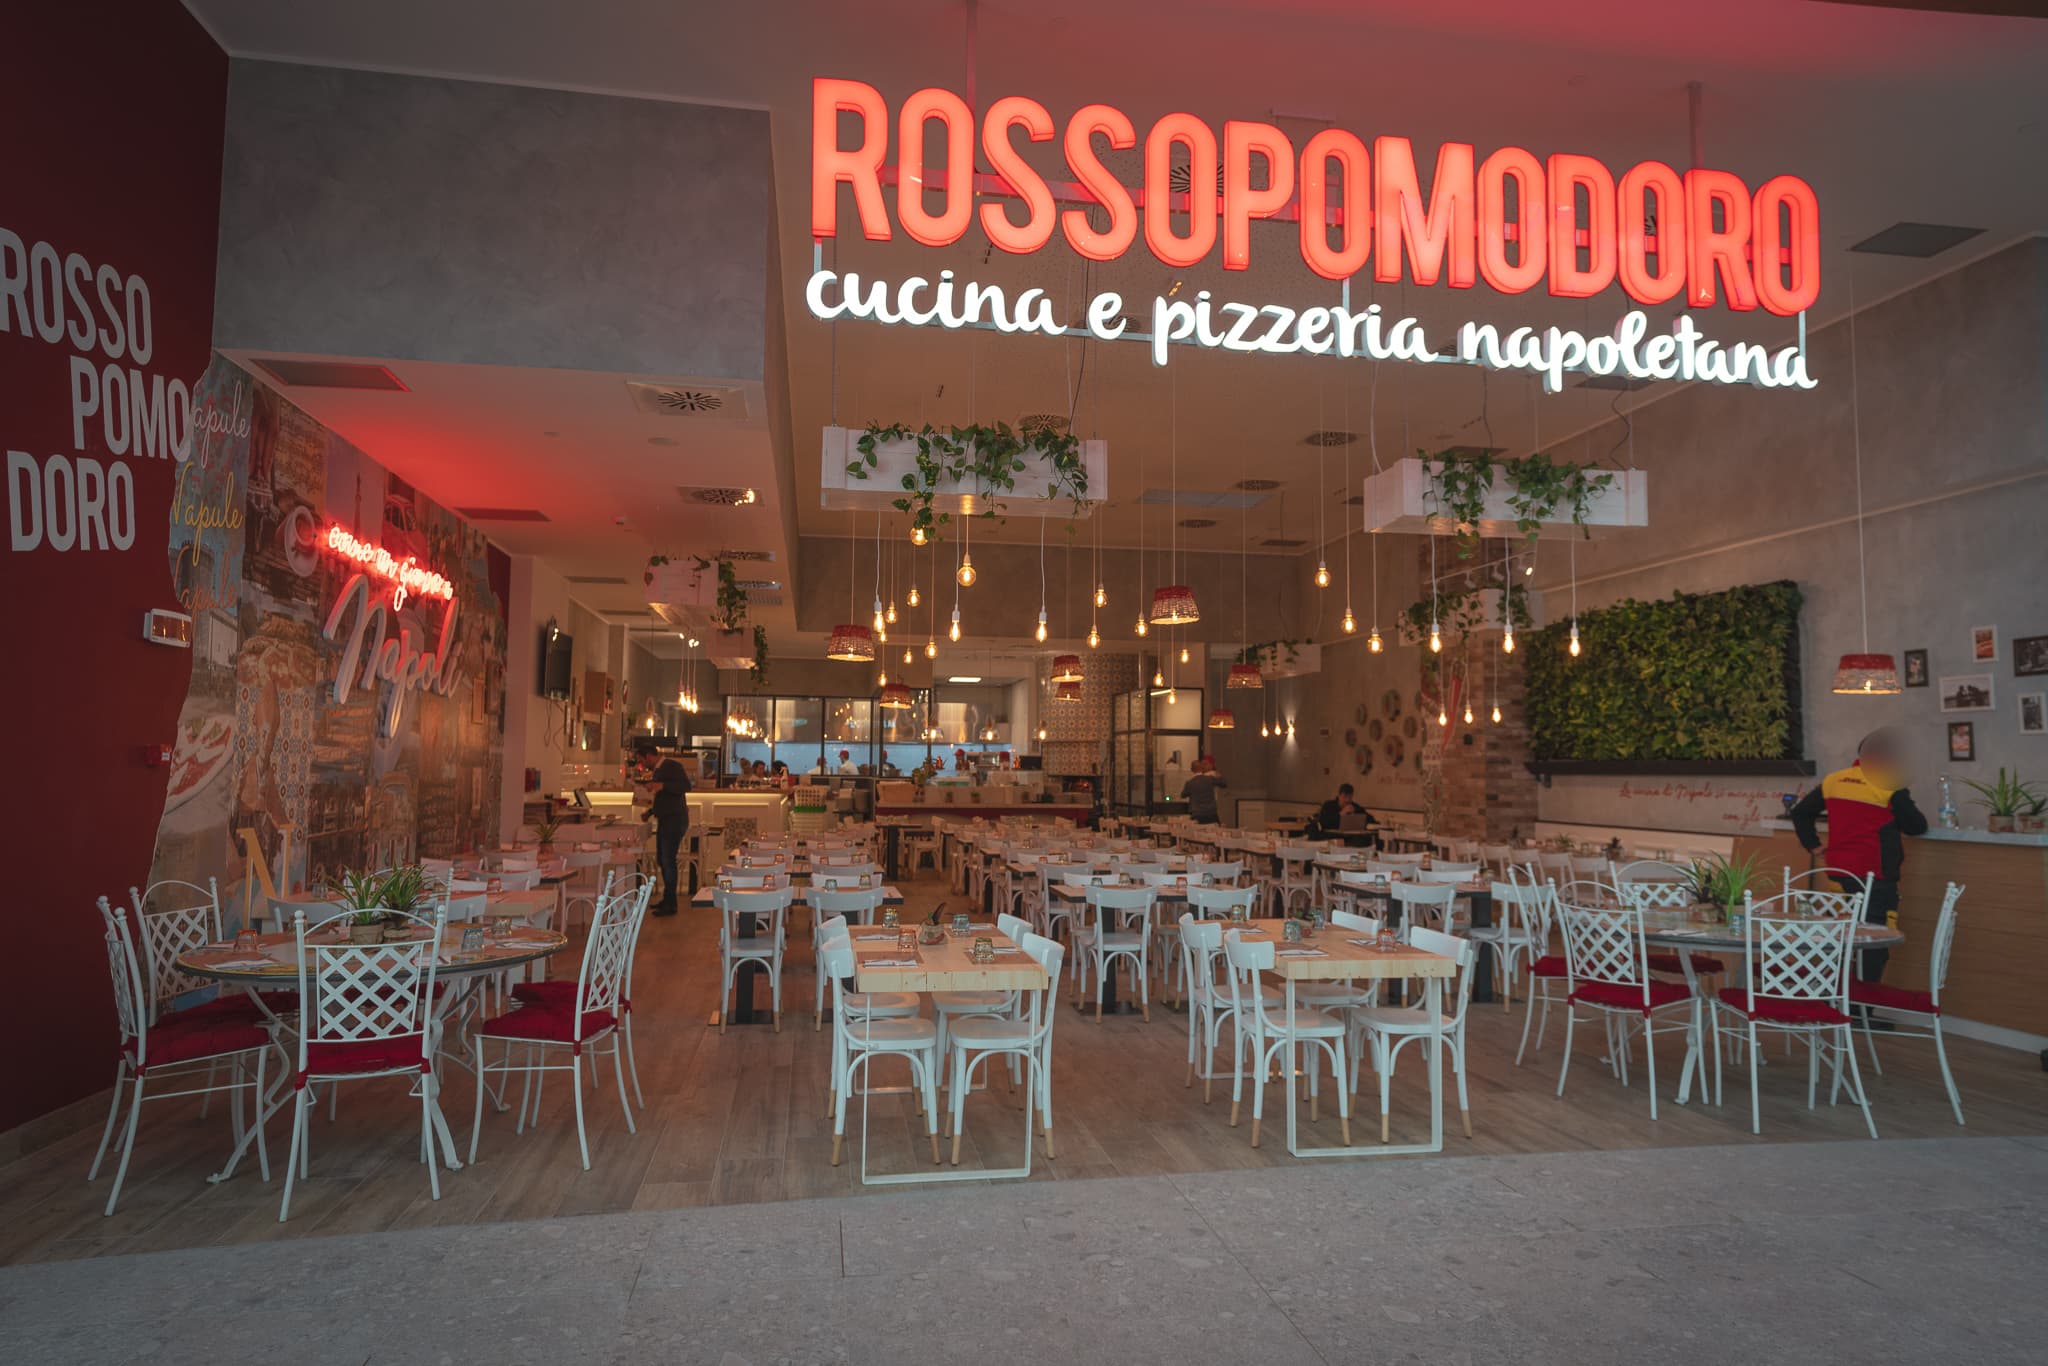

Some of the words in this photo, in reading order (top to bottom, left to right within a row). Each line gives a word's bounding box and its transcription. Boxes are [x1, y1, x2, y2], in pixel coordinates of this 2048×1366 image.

[812, 77, 1820, 317] ROSSOPOMODORO
[0, 228, 152, 366] ROSSO
[806, 270, 1067, 336] cucina
[1088, 292, 1127, 341] e
[1152, 290, 1439, 367] pizzeria
[1457, 310, 1819, 394] napoletana
[70, 355, 193, 463] POMO
[6, 450, 135, 552] DORO
[322, 574, 463, 738] Napoli
